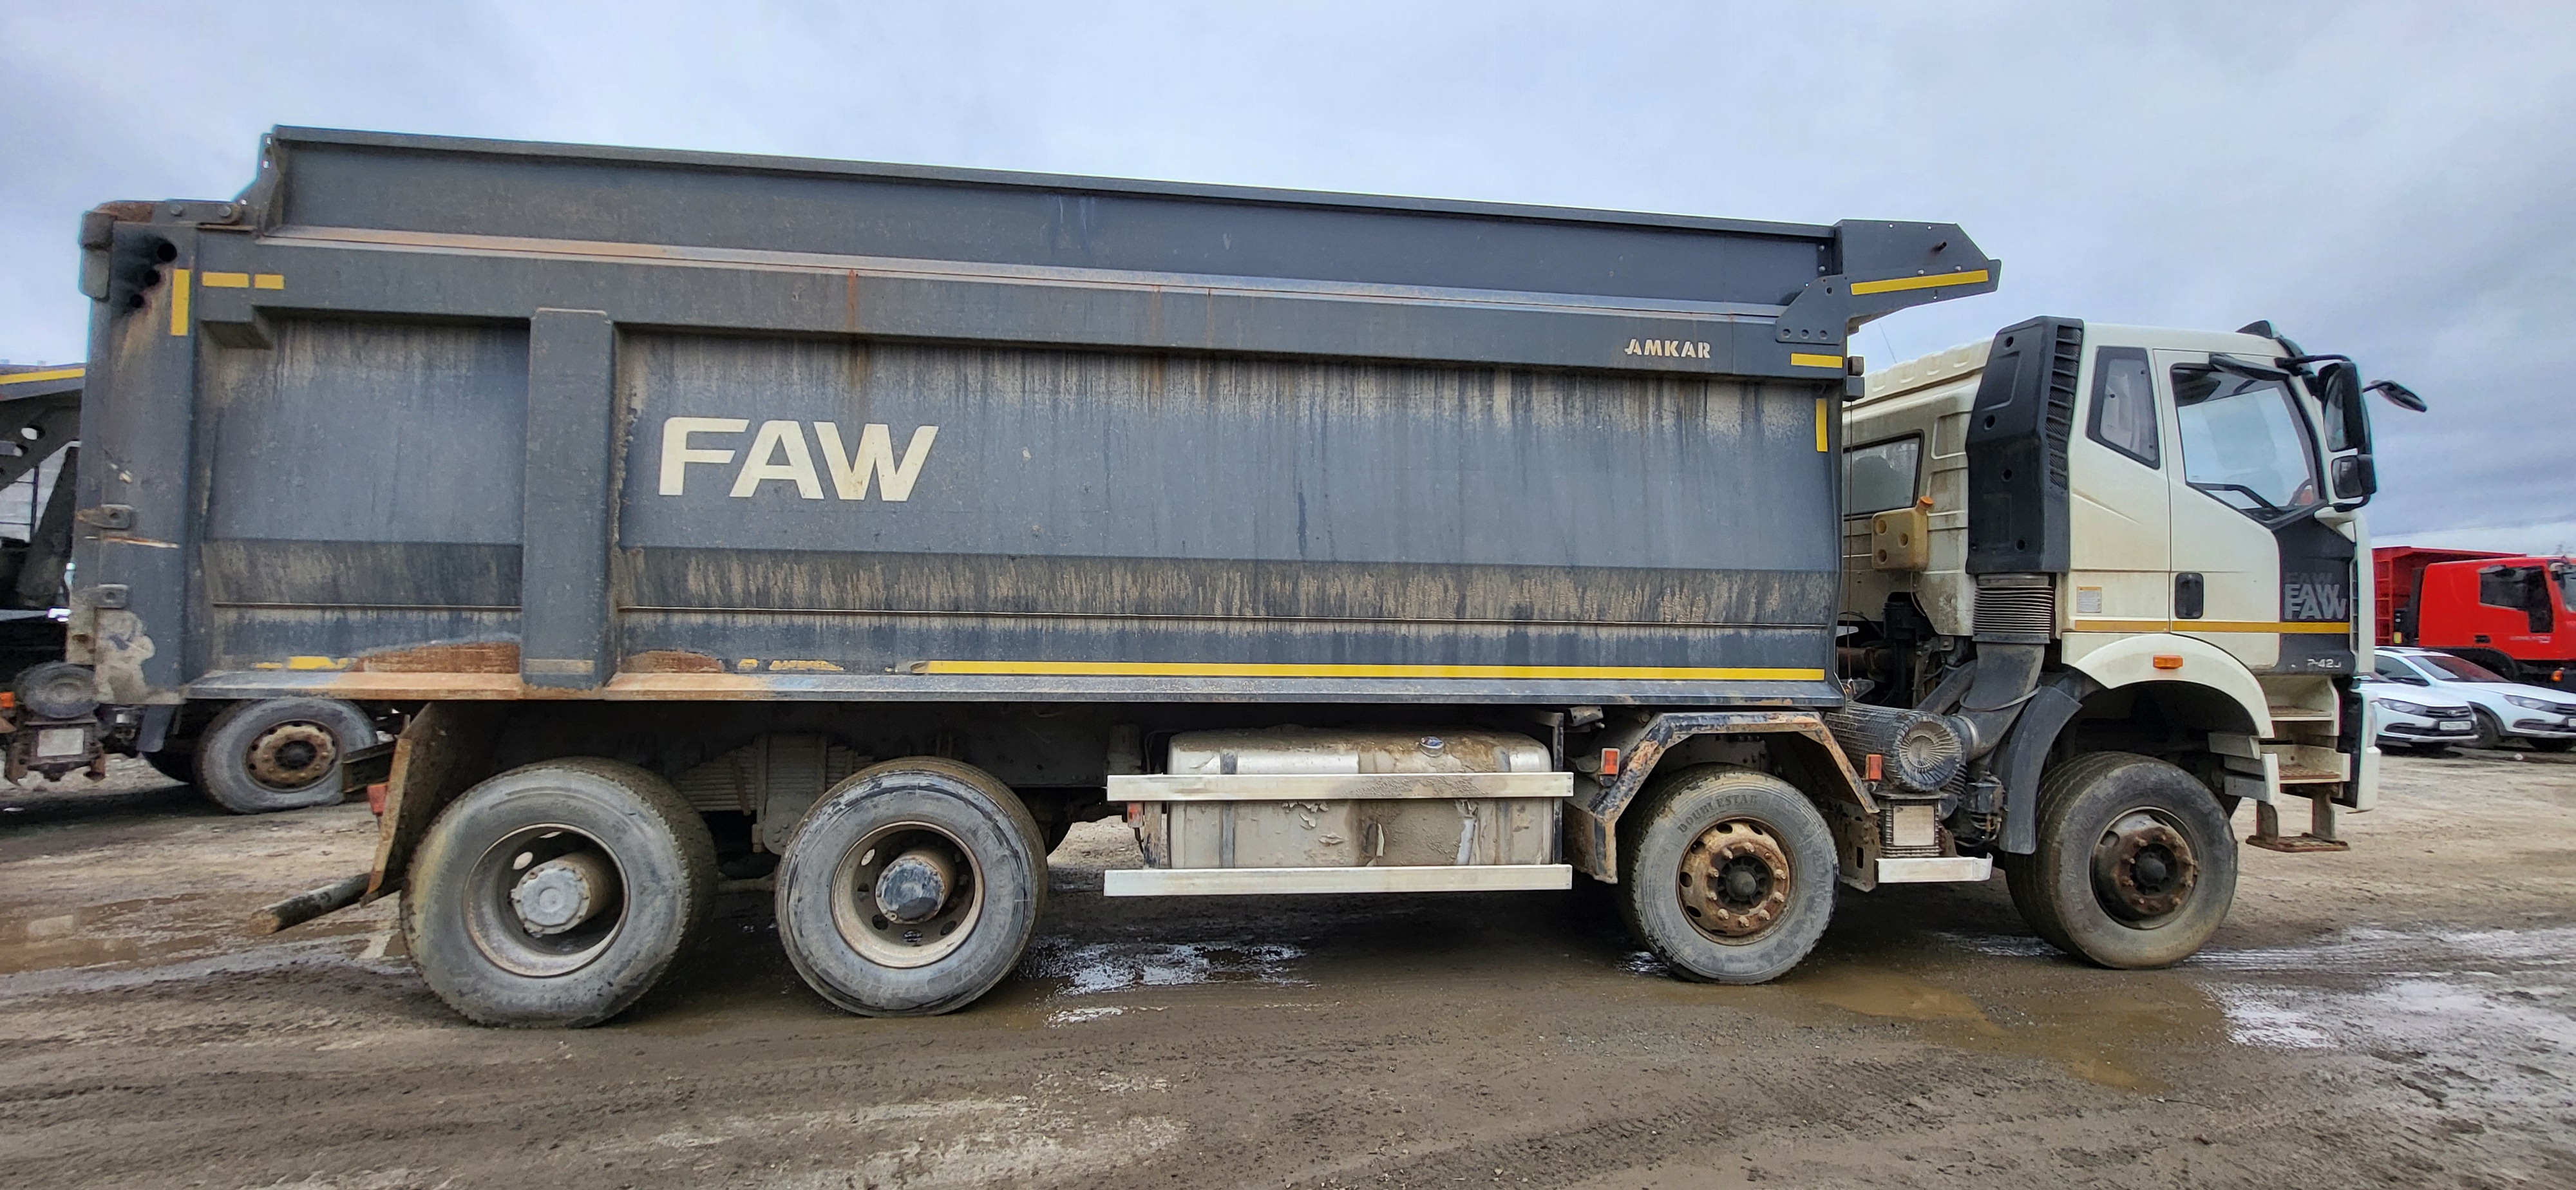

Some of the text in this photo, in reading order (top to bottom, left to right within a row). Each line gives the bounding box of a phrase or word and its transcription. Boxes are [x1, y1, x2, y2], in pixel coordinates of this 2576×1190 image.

[1624, 339, 1710, 358] AMKAR
[659, 417, 939, 502] FAW
[2284, 598, 2347, 619] FAW
[1677, 795, 1758, 833] DOUBLESTAR
